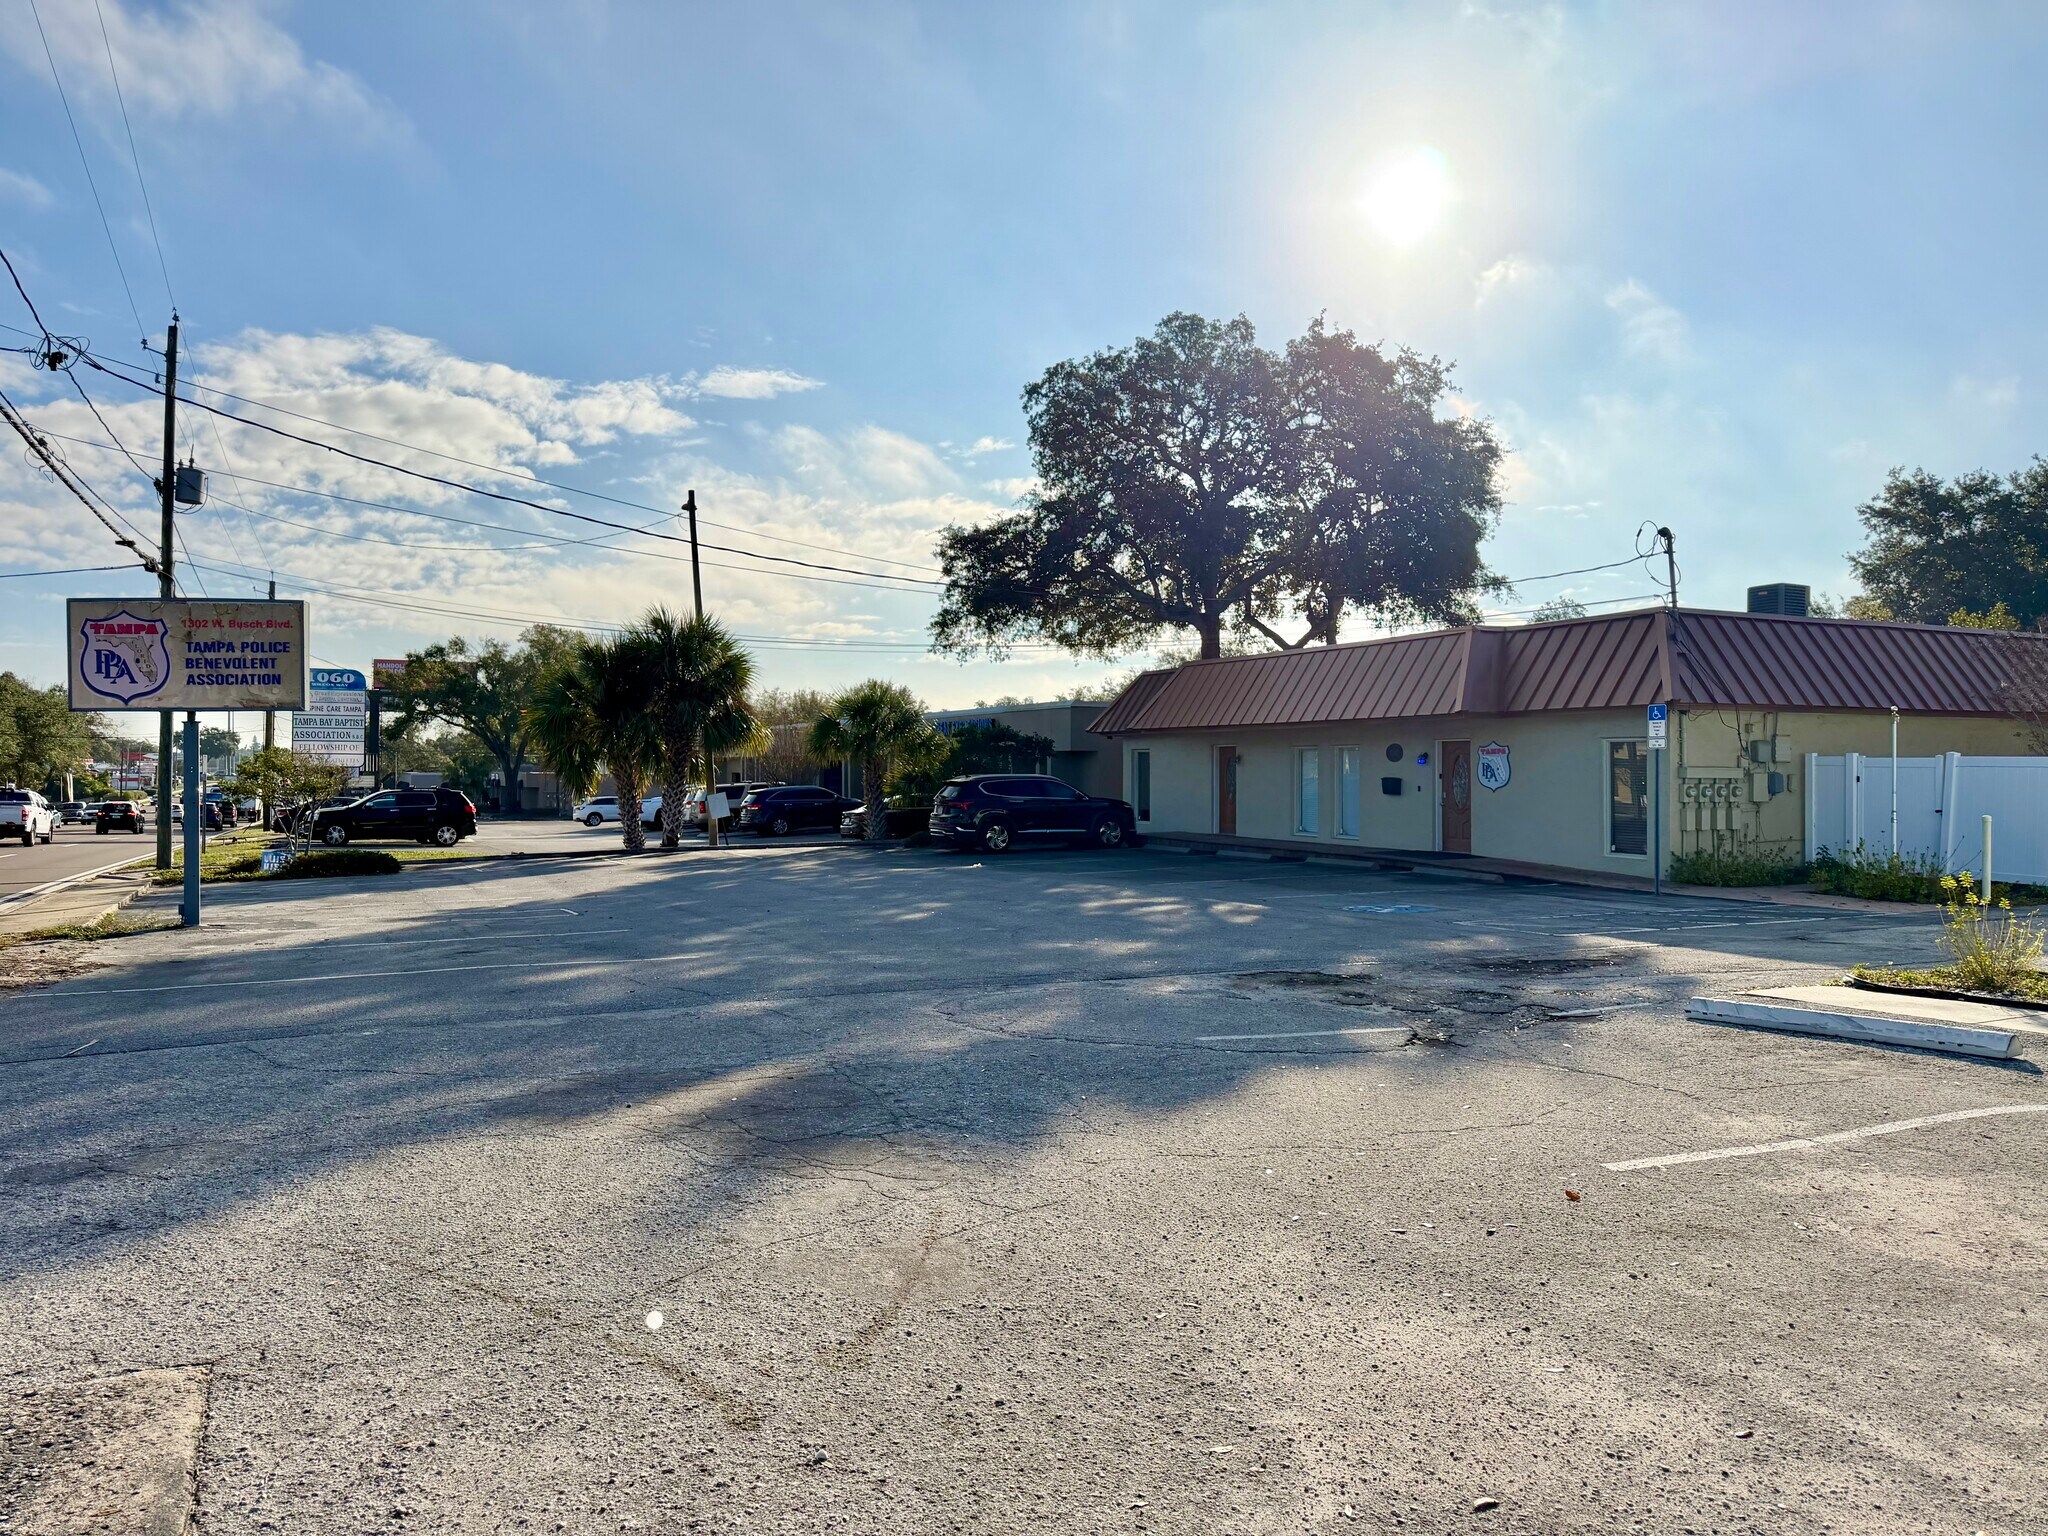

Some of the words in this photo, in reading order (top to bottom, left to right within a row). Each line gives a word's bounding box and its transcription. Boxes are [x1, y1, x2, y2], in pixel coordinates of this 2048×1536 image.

[90, 624, 159, 634] TAMPA
[181, 619, 208, 629] 1302
[228, 619, 263, 629] Busch
[266, 619, 293, 629] Blvd.
[185, 641, 235, 653] TAMPA
[240, 641, 290, 653] POLICE
[185, 657, 278, 669] BENEVOLENT
[186, 673, 282, 686] ASSOCIATION
[294, 718, 318, 726] TAMPA
[320, 718, 334, 726] BAY
[334, 719, 364, 727] BAPTIST
[294, 731, 351, 739] ASSOCIATION
[298, 744, 348, 752] FELLOWSHIP
